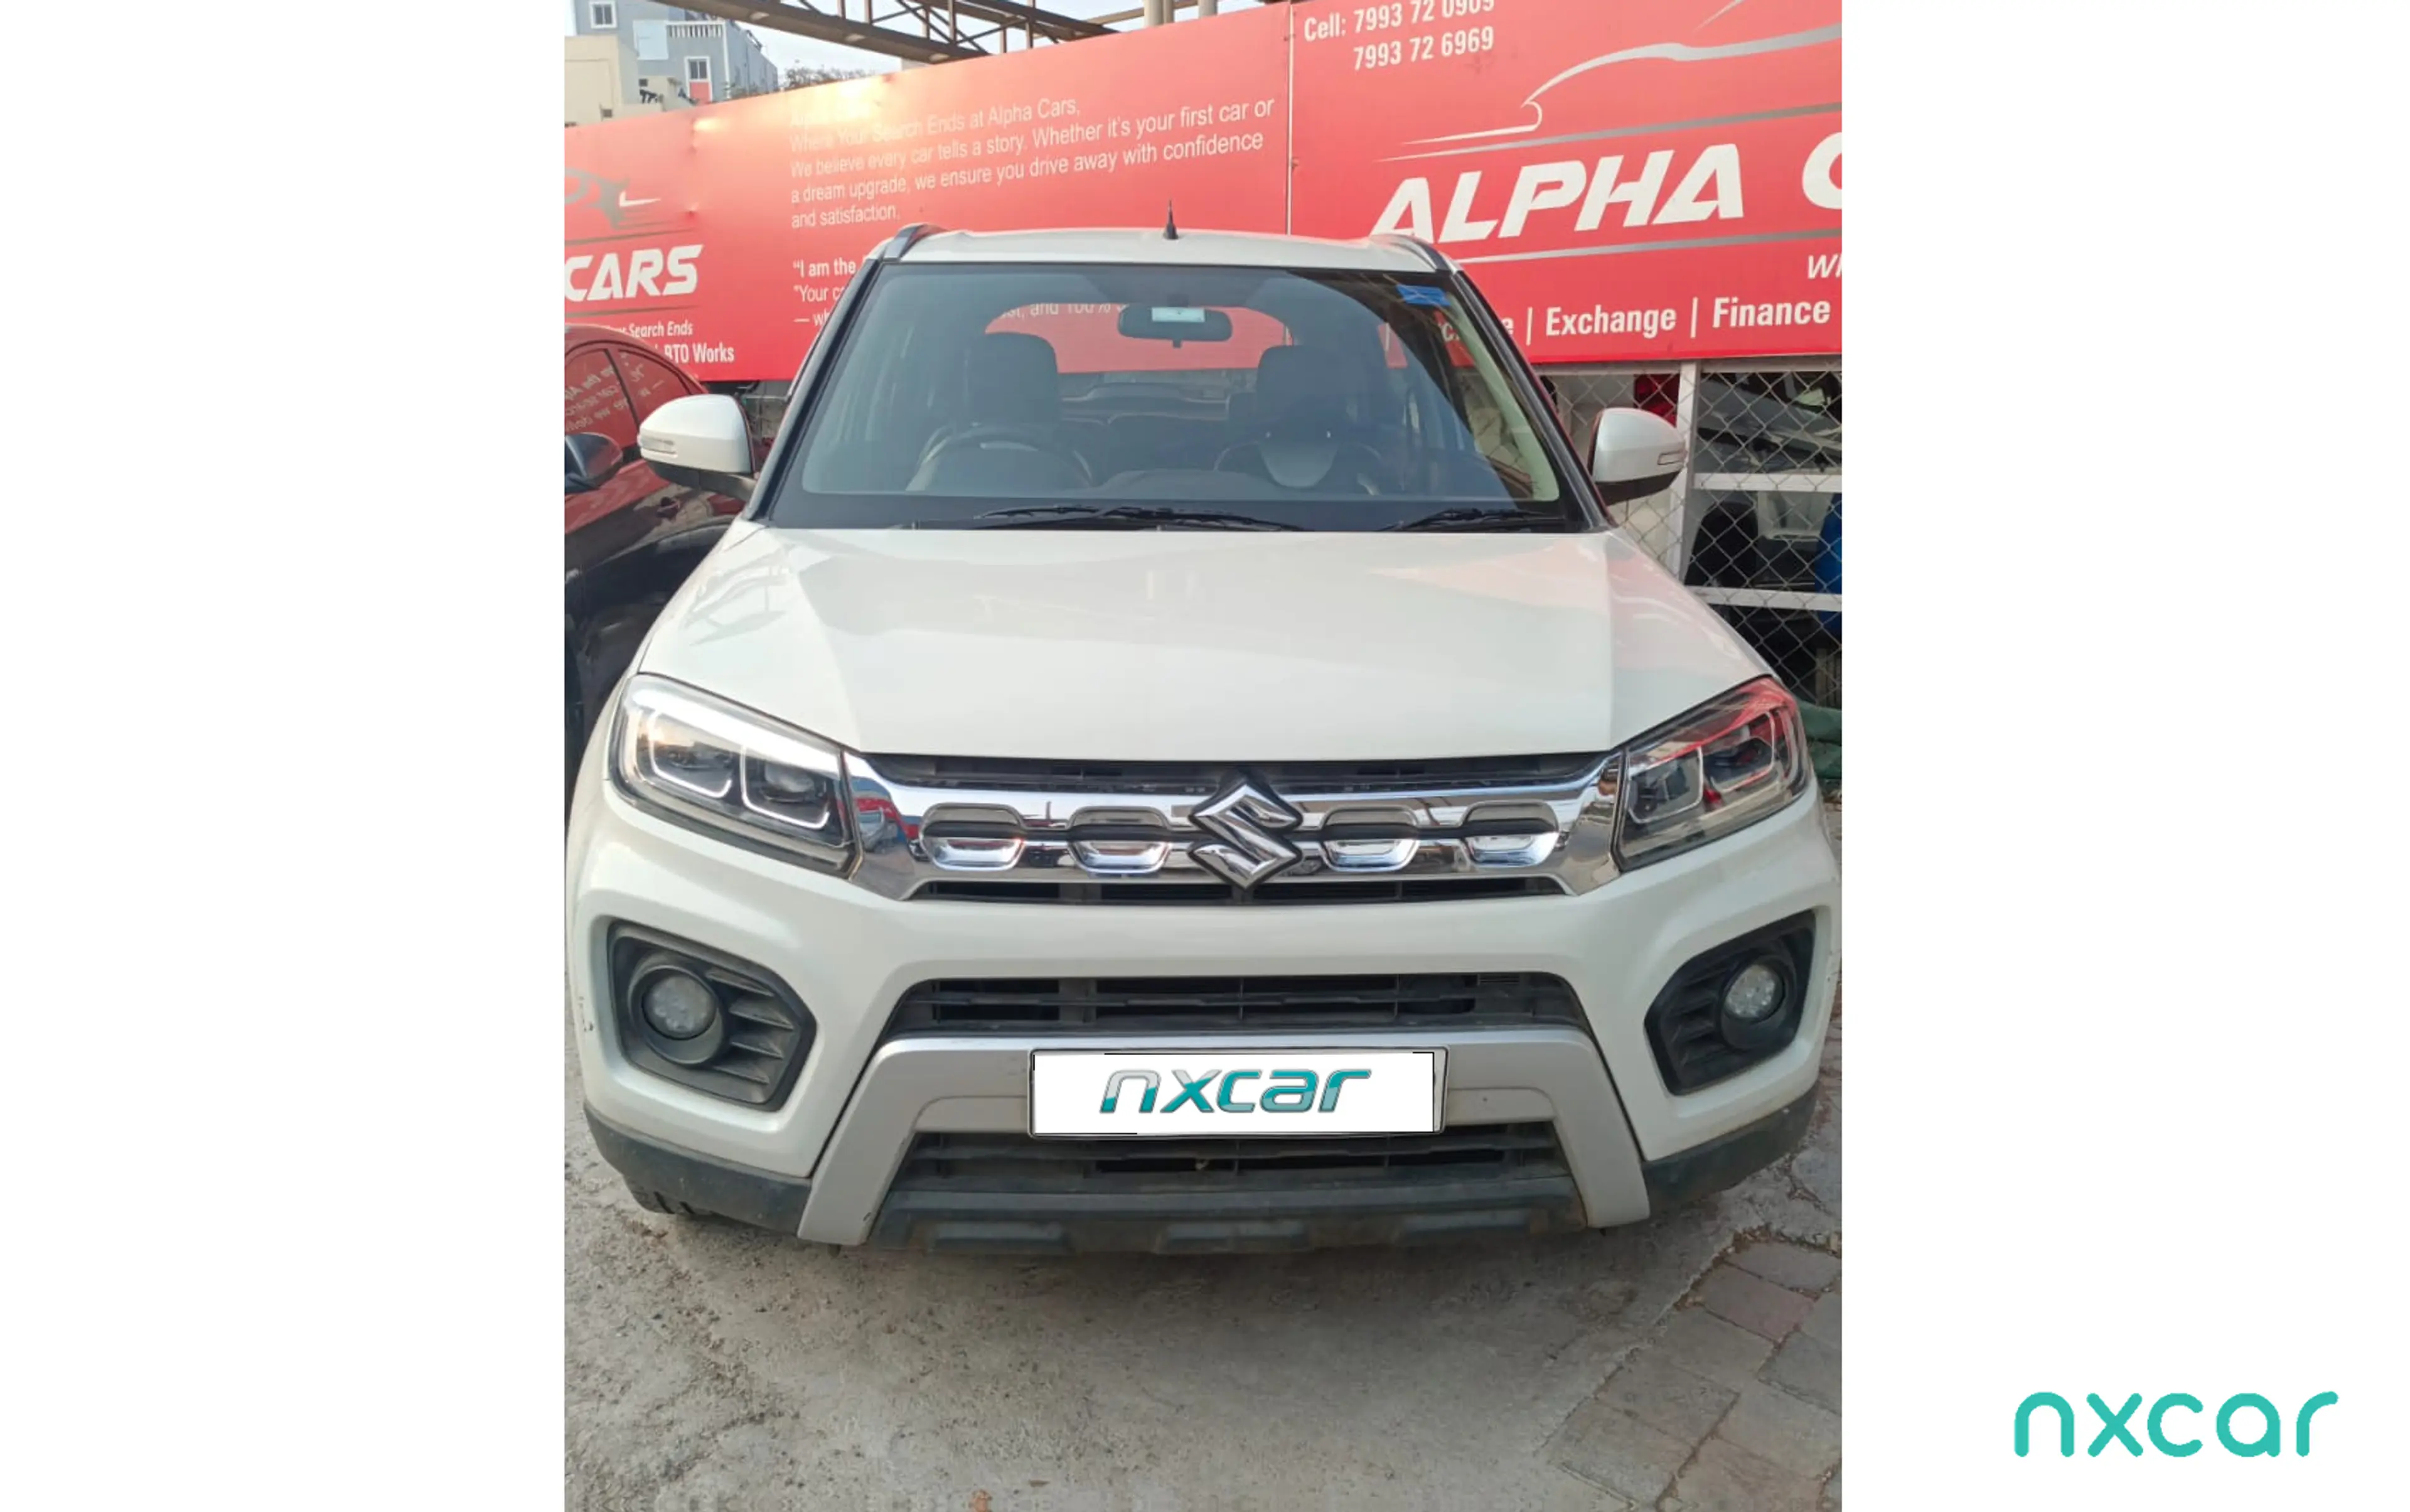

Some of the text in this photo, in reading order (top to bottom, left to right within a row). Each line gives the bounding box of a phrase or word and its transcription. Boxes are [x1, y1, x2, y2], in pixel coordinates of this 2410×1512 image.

[1304, 12, 1346, 41] Cell:
[1353, 3, 1403, 33] 7993
[1410, 0, 1435, 24] 72
[1352, 26, 1494, 71] 7993 72 6969
[927, 111, 965, 134] Ends
[970, 110, 983, 129] at
[988, 103, 1032, 129] Alpha
[1037, 98, 1081, 119] Cars,
[791, 159, 812, 178] We
[817, 155, 865, 176] believe
[868, 153, 906, 170] every
[911, 146, 933, 164] car
[938, 139, 968, 161] tells
[972, 141, 982, 156] a
[1032, 123, 1103, 149] Whether
[1107, 115, 1131, 137] it's
[1135, 113, 1176, 140] your
[1180, 104, 1213, 128] first
[1219, 102, 1250, 122] car
[1254, 98, 1275, 118] or
[791, 131, 1264, 204] a dream upgrade, we ensure you drive away with confidence
[1369, 143, 1744, 244] ALPHA
[791, 204, 901, 229] and satisfaction.
[564, 243, 704, 302] CARS
[808, 262, 830, 278] am
[833, 257, 857, 276] the
[667, 319, 694, 337] Ends
[1545, 304, 1678, 340] Exchange
[1712, 296, 1831, 328] Finance
[692, 341, 736, 363] Works
